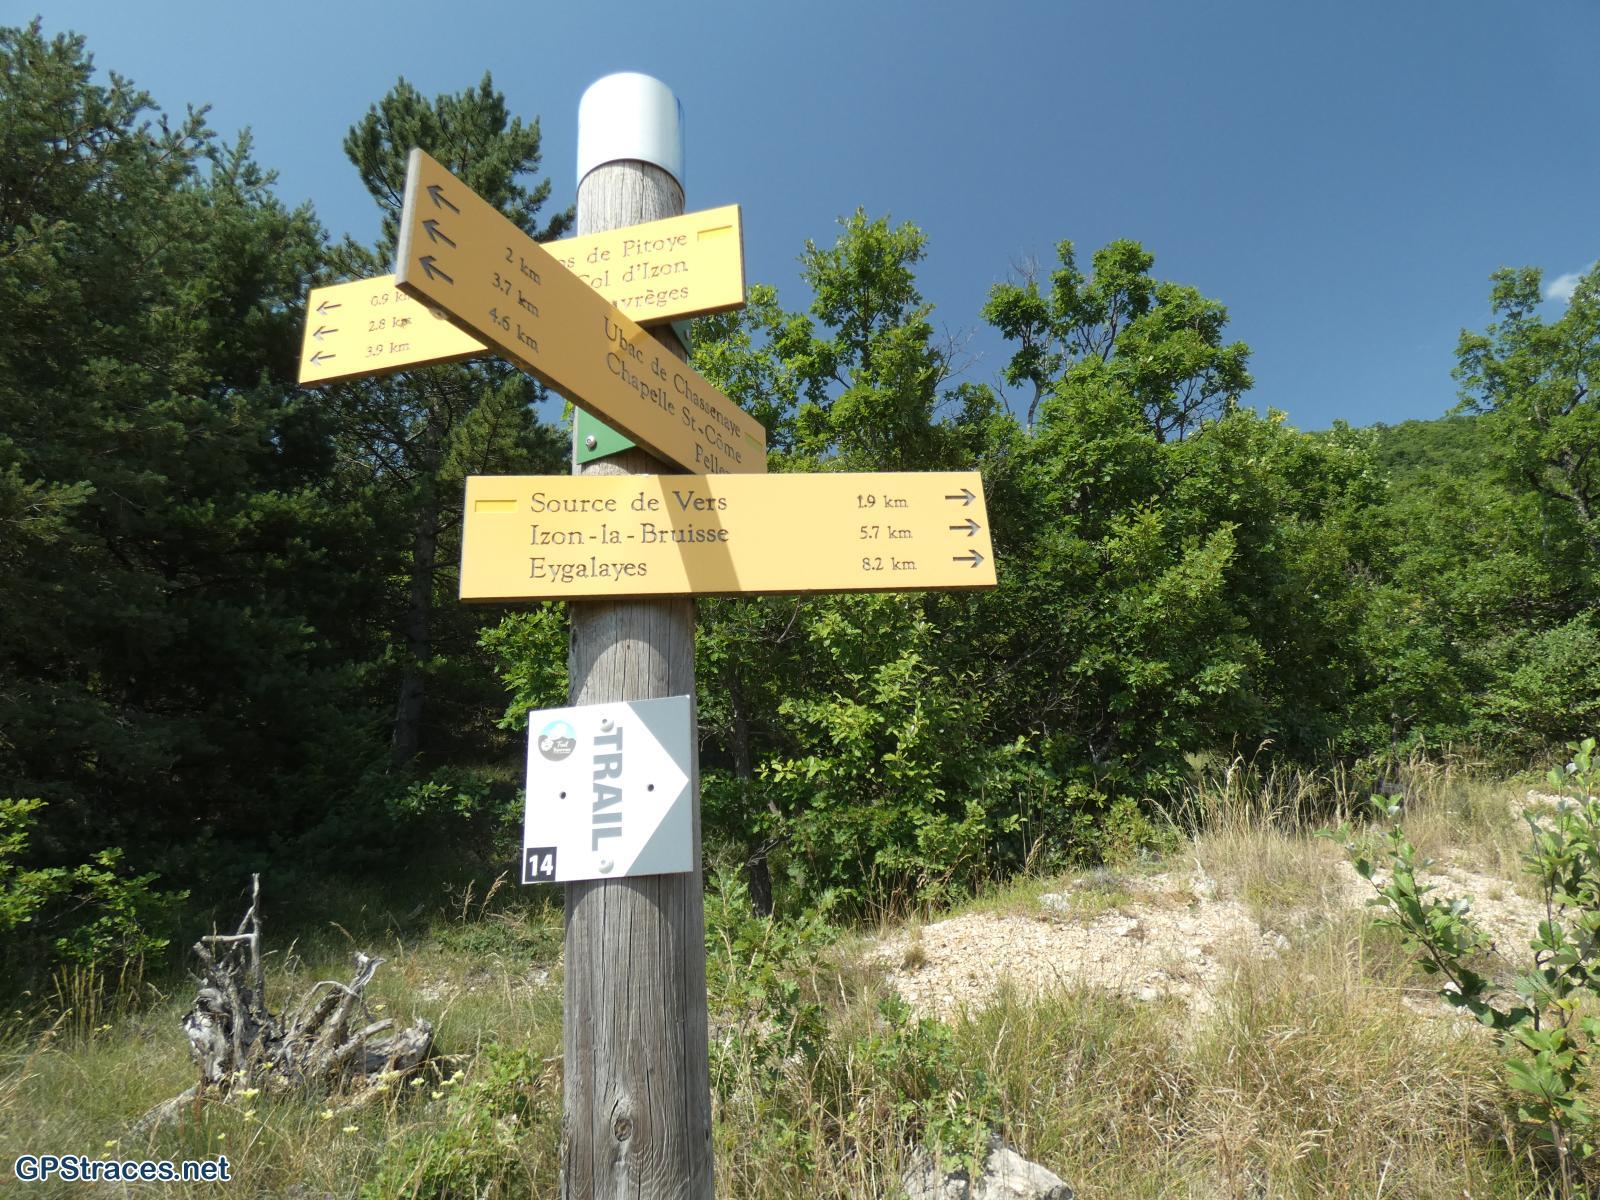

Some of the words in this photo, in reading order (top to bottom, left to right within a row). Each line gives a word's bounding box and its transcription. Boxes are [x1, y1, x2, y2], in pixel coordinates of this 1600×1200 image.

[586, 246, 611, 264] de
[622, 234, 688, 258] Pitoye
[505, 246, 514, 264] 2
[519, 257, 542, 286] km
[622, 260, 689, 282] d'Izon
[492, 272, 513, 296] 3.7
[517, 289, 540, 318] km
[368, 318, 386, 332] 2.8
[489, 307, 511, 331] 4.6
[516, 323, 540, 354] km
[389, 342, 411, 354] km
[603, 316, 645, 364] Ubac
[650, 356, 668, 382] de
[672, 373, 742, 439] Chassenaye
[606, 352, 677, 416] Chapelle
[530, 492, 618, 513] Source
[630, 491, 660, 512] de
[672, 490, 728, 512] Vers
[857, 494, 877, 509] 1.9
[883, 494, 909, 508] km
[860, 525, 880, 540] 5.7
[887, 525, 914, 539] km
[529, 556, 648, 583] Eygalayes
[862, 557, 884, 572] 8.2
[890, 556, 918, 571] km
[591, 726, 624, 852] TRAIL
[529, 854, 554, 877] 14
